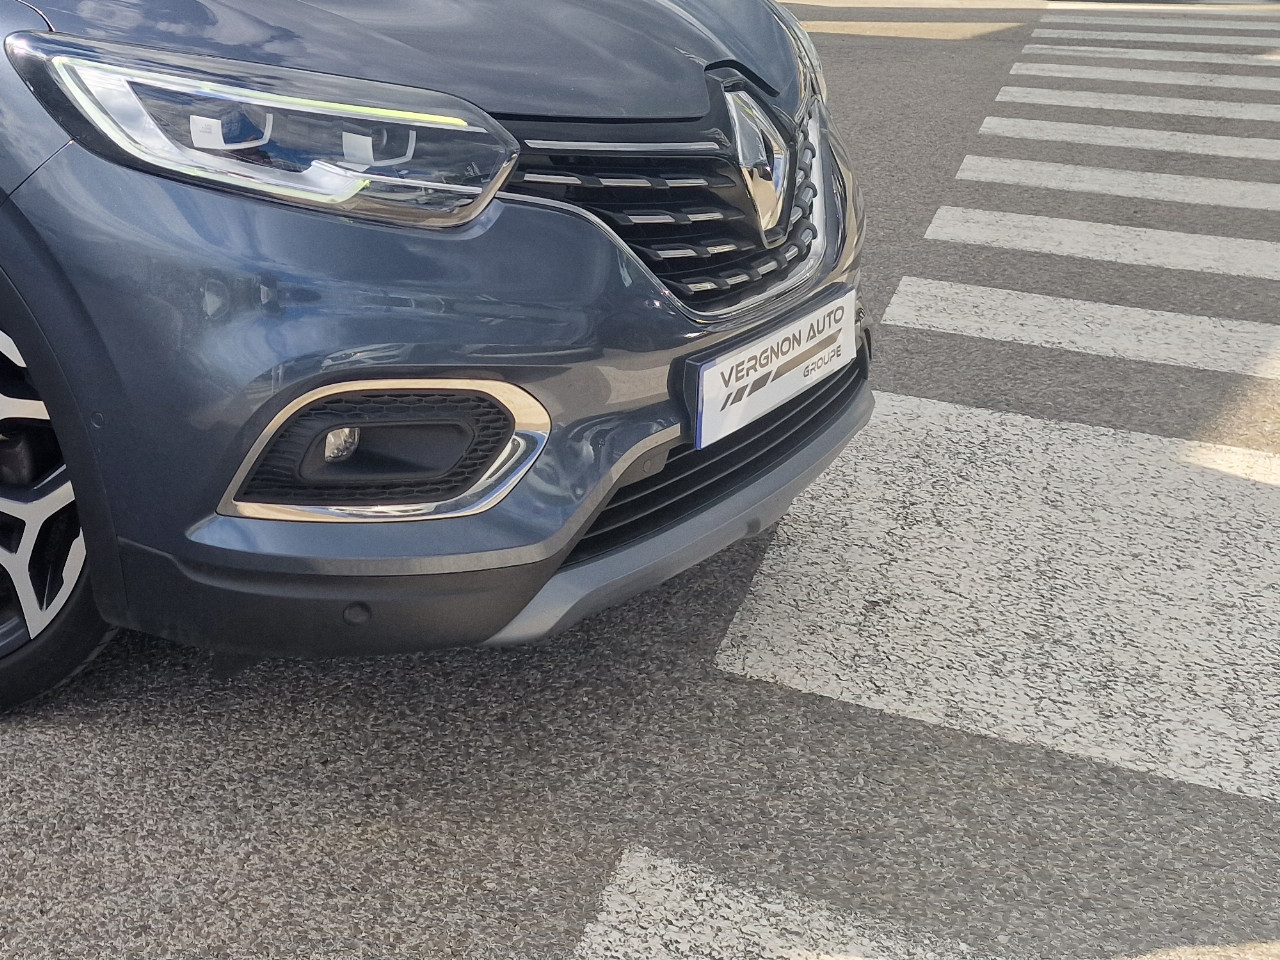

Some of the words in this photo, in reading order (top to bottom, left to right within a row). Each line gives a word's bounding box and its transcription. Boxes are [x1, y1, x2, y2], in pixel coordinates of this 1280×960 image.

[720, 329, 802, 389] VERGNON
[805, 305, 845, 343] AUTO
[803, 344, 842, 378] GROUPE
